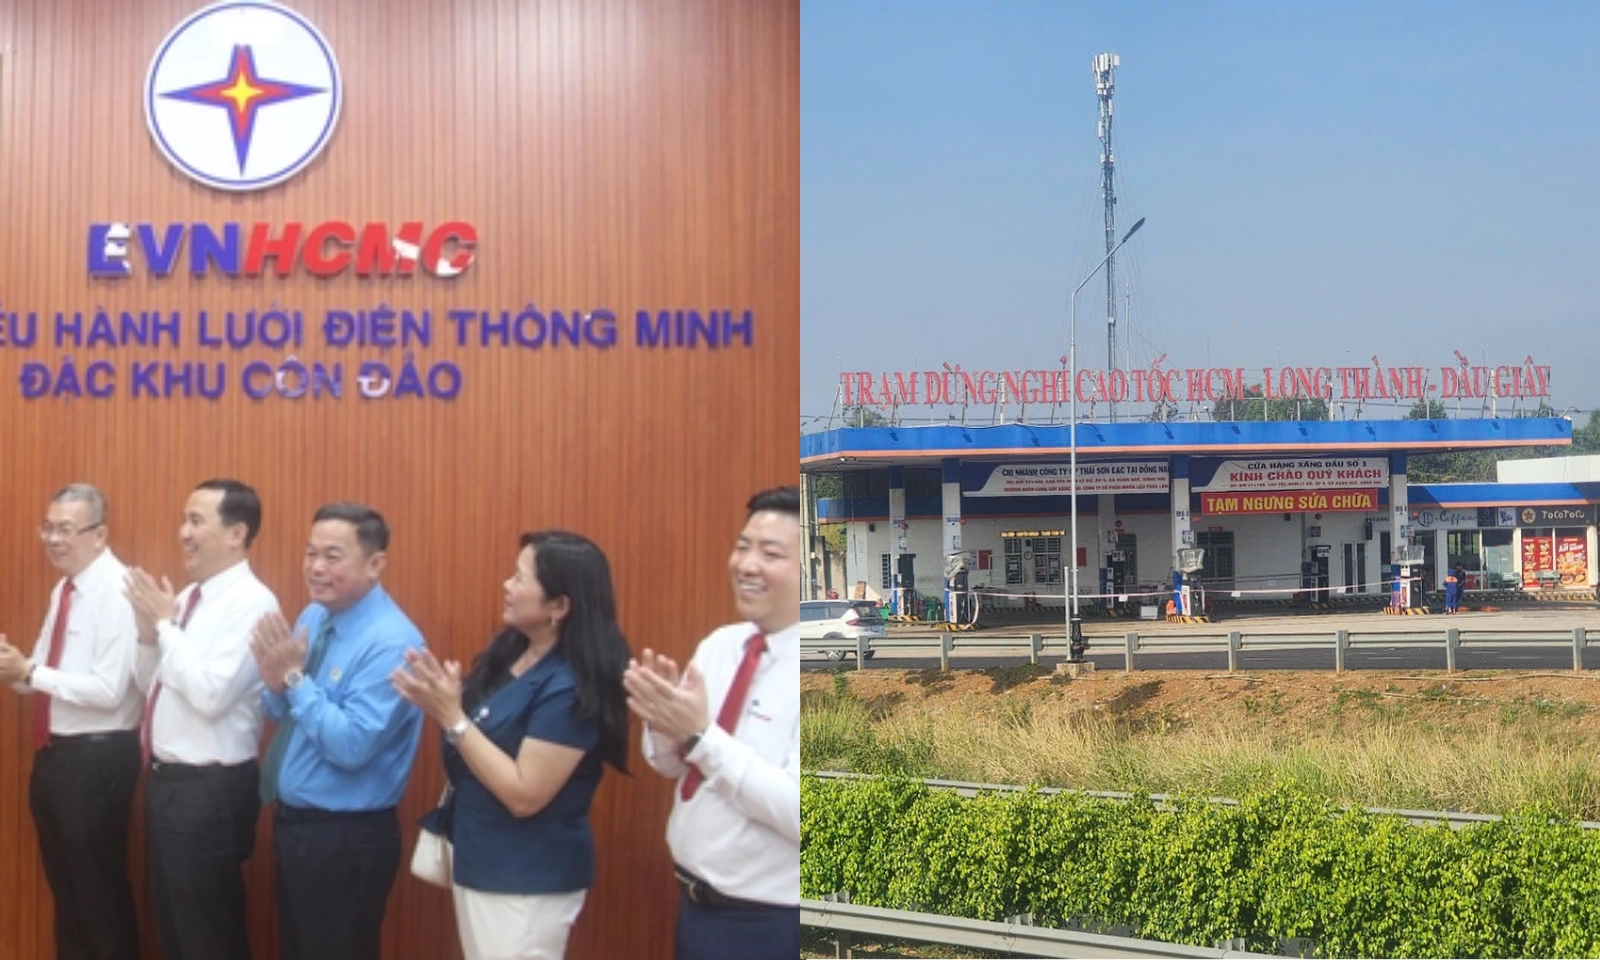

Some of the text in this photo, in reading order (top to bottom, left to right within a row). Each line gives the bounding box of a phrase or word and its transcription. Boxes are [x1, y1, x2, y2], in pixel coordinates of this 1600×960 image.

[87, 221, 478, 278] EVNHCMC
[54, 305, 181, 348] HÀNH
[322, 303, 431, 350] ĐIỆN
[447, 303, 618, 349] THÔNG
[635, 309, 753, 348] MINH
[19, 355, 115, 402] ĐẶC
[131, 361, 226, 398] KHU
[242, 355, 343, 399] CÔN
[840, 371, 918, 411] TRẠM
[924, 361, 999, 405] DỪNG
[1001, 355, 1070, 405] NGHỈ
[1075, 368, 1125, 404] CAO
[1132, 353, 1182, 404] TỐC
[1186, 367, 1245, 402] HCM
[1264, 366, 1332, 401] LONG
[1336, 355, 1425, 400] THÀNH
[1440, 349, 1490, 399] DẦU
[1493, 355, 1552, 398] GIÂY
[1059, 468, 1068, 476] TY
[1230, 467, 1382, 482] KÍNH CHÀO QUÝ KHÁCH
[1247, 461, 1267, 470] CỬA
[1269, 460, 1295, 469] HÀNG
[1346, 458, 1359, 467] SỐ
[1206, 497, 1238, 514] TẠM
[1242, 495, 1294, 511] NGƯNG
[1298, 491, 1328, 509] SỬA
[1332, 492, 1372, 508] CHỮA
